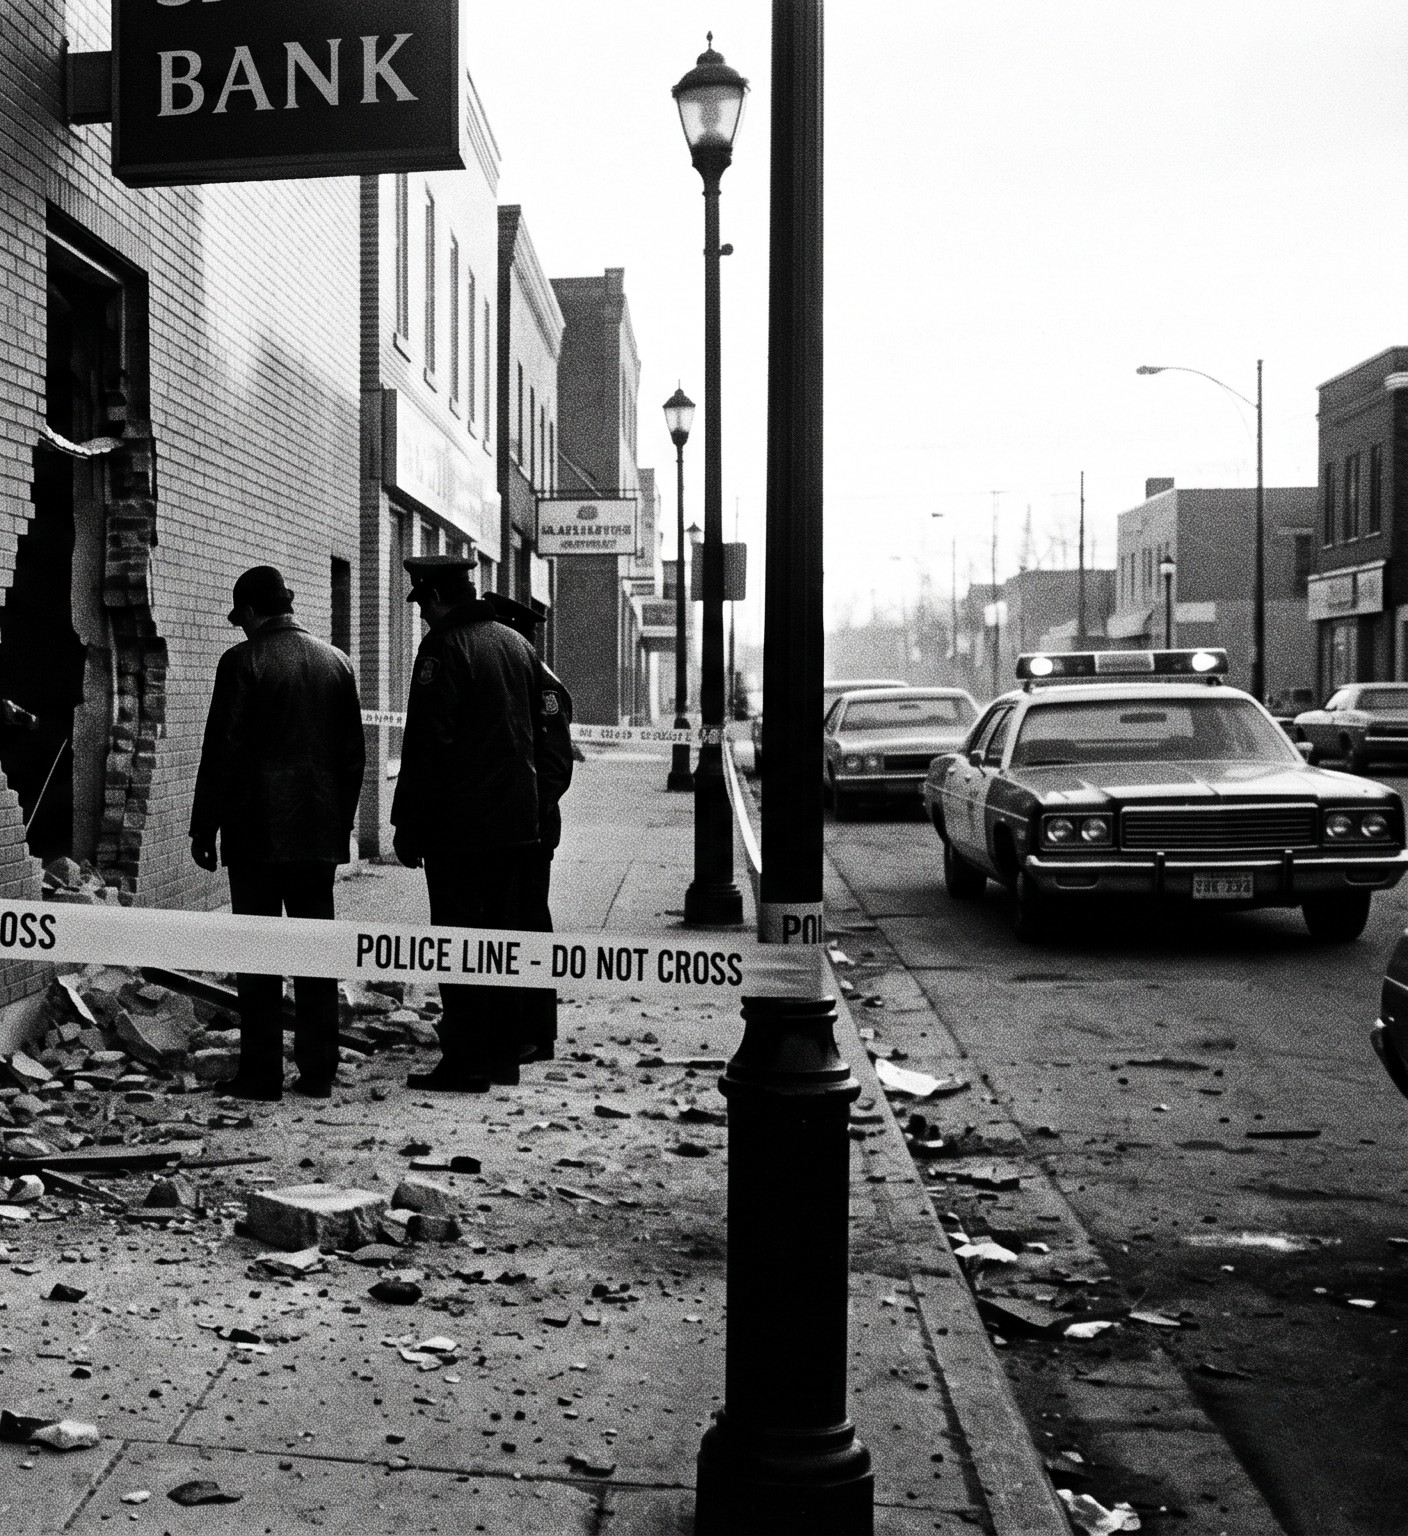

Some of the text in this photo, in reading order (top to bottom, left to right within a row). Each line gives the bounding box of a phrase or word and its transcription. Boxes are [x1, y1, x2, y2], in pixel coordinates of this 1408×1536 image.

[157, 33, 419, 117] BANK
[356, 933, 453, 972] POLICE
[461, 939, 521, 975] LINE
[552, 944, 587, 979] DO
[596, 946, 650, 982] NOT
[657, 949, 744, 987] CROSS
